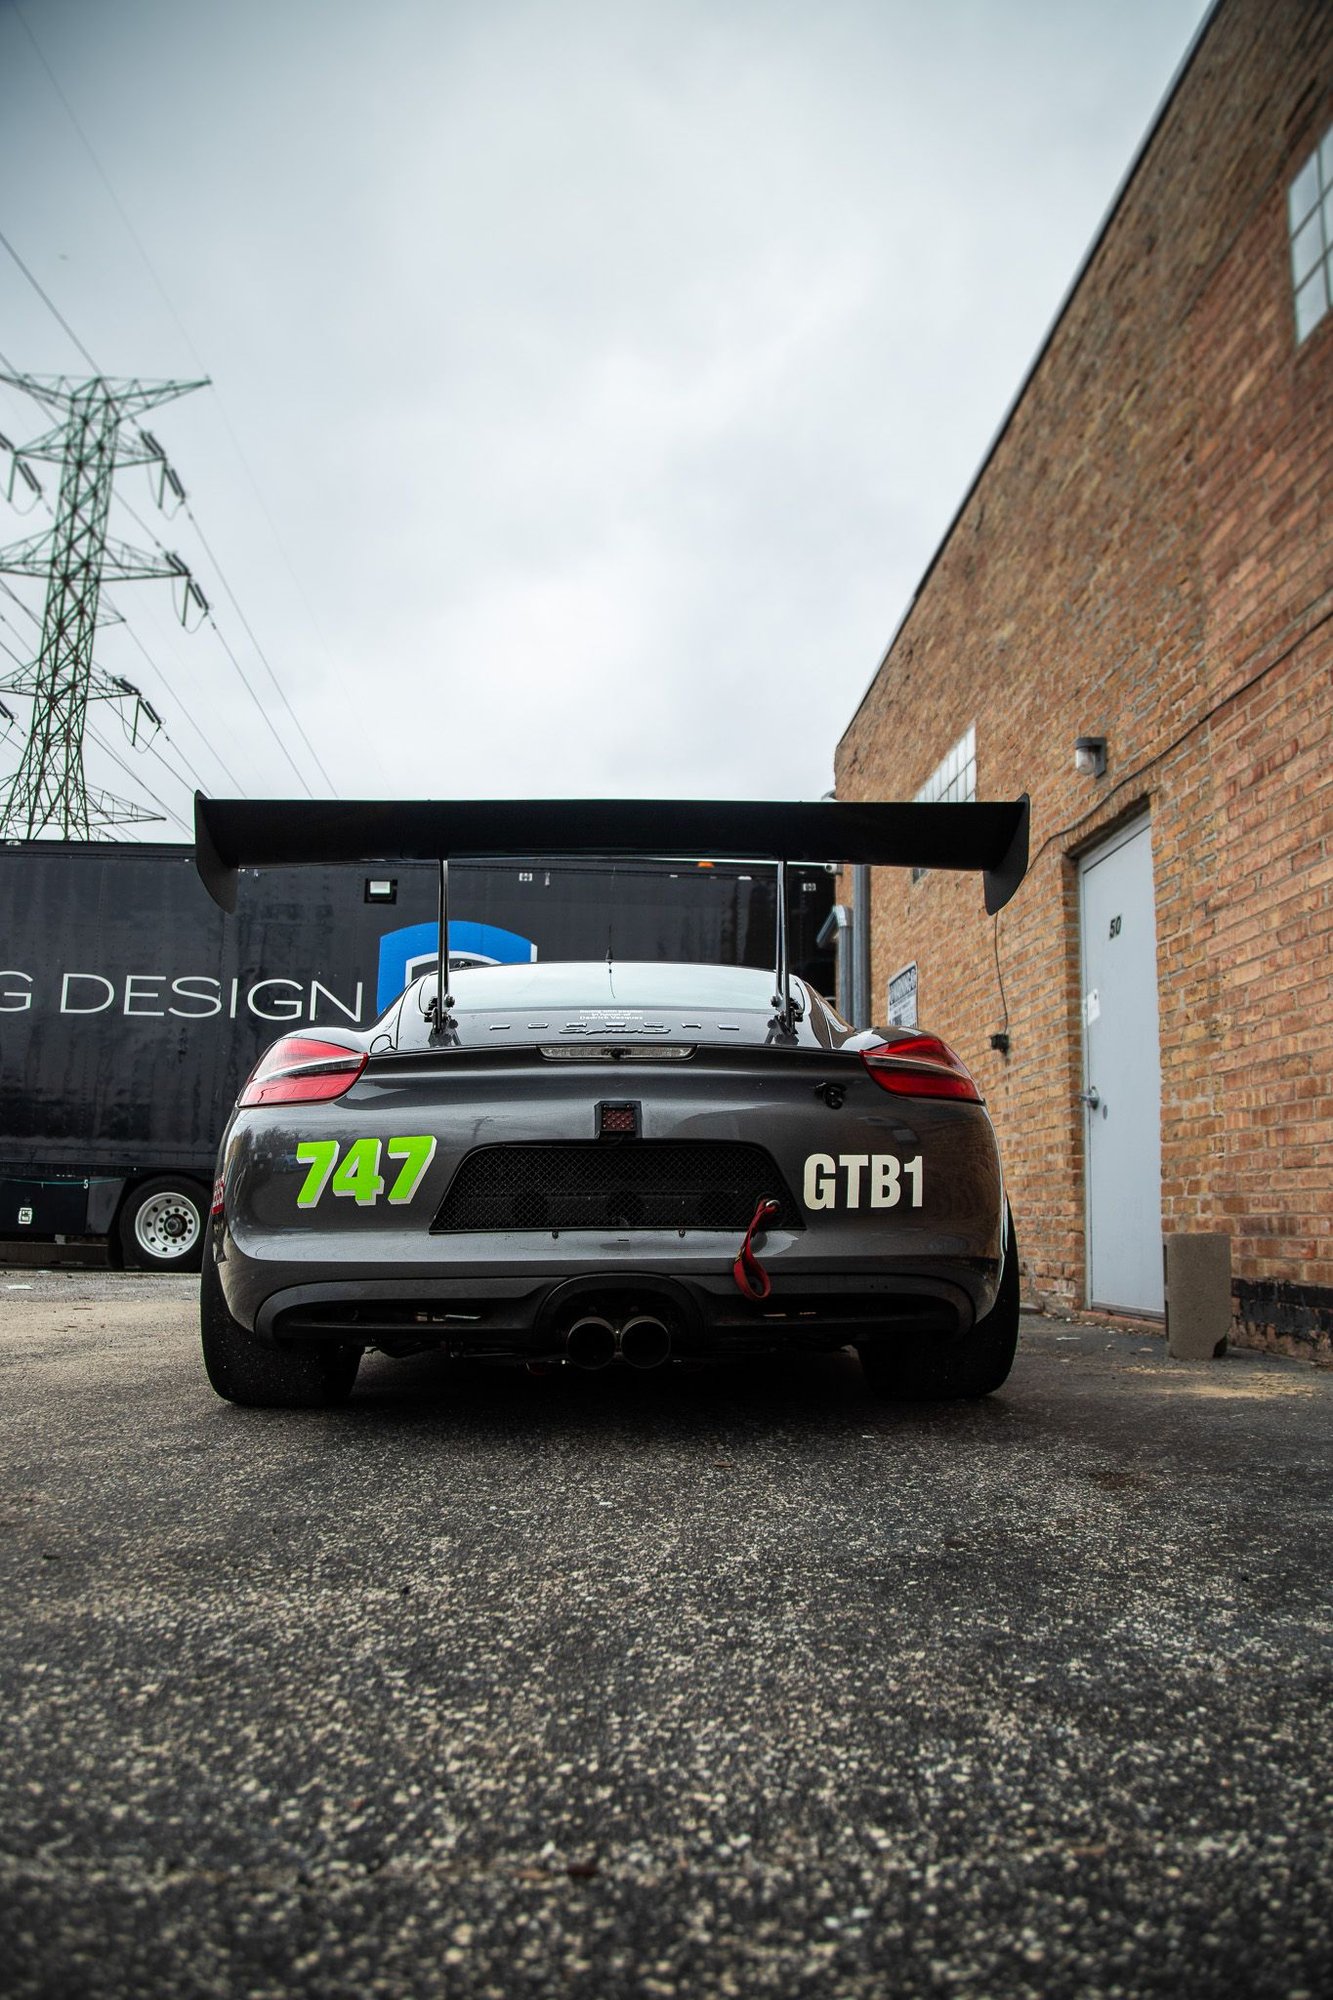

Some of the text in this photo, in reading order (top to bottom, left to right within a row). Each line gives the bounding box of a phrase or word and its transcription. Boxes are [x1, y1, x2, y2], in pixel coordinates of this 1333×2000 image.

[1109, 914, 1122, 940] 50
[60, 973, 363, 1023] DESIGN
[296, 1135, 438, 1209] 747
[803, 1153, 923, 1210] GTB1
